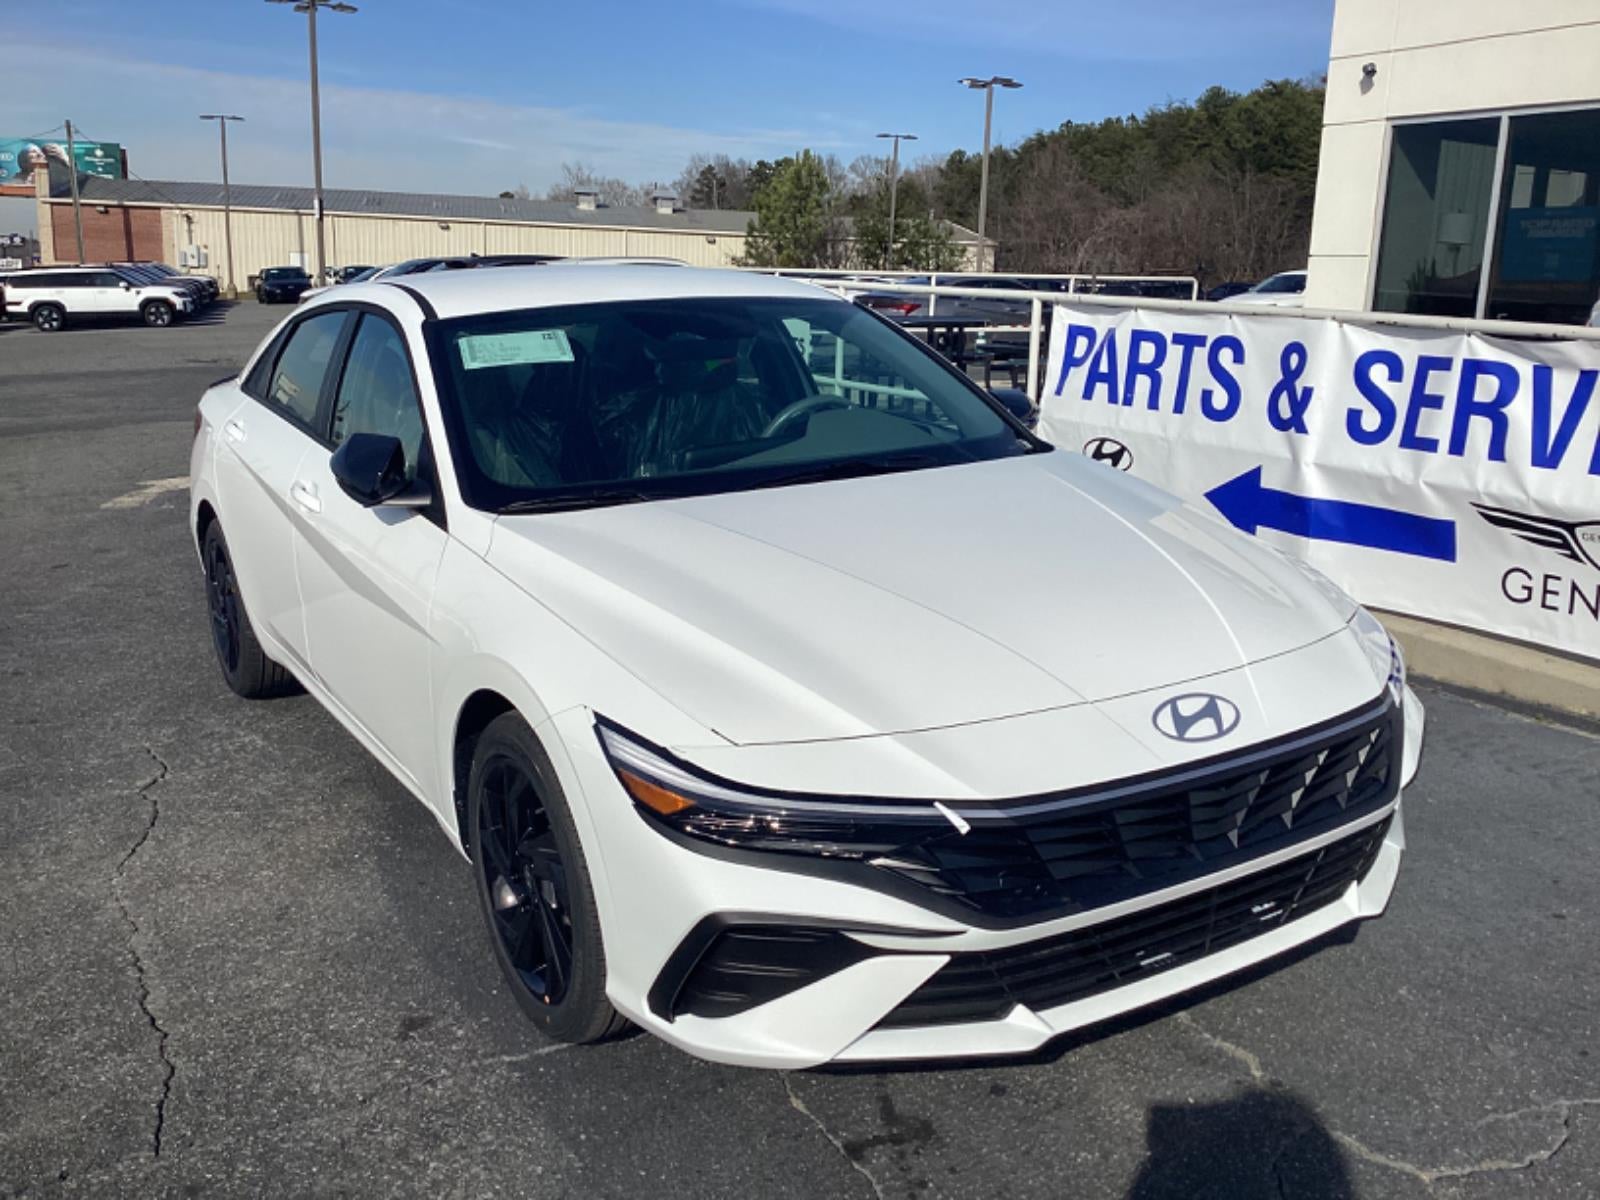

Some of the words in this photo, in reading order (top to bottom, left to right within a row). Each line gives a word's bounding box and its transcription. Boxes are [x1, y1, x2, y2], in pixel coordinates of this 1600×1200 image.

[1054, 324, 1246, 422] PARTS
[1267, 341, 1314, 435] &
[1346, 350, 1600, 476] SERV
